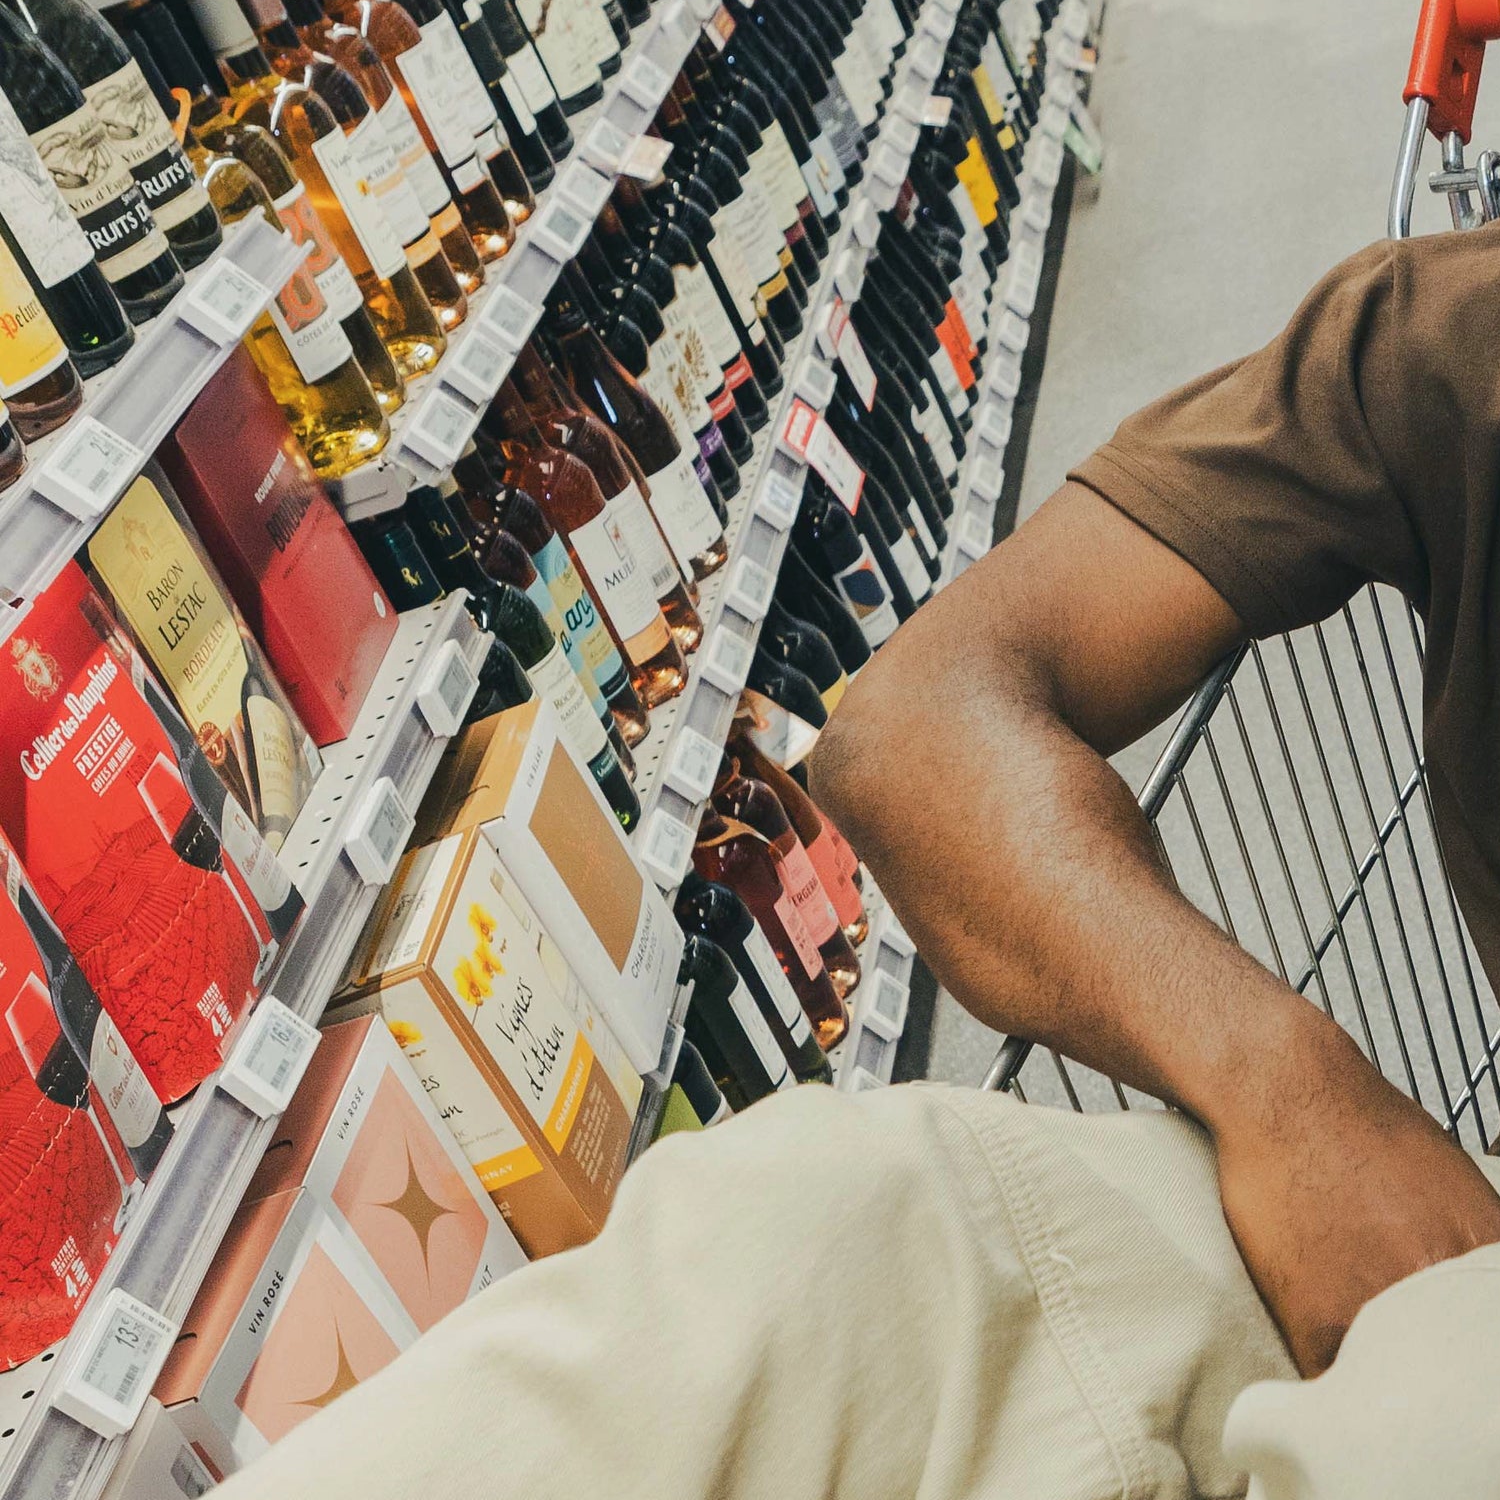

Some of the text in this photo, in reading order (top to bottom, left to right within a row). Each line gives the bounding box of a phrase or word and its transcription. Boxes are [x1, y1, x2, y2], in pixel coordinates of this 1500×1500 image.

[254, 477, 275, 504] ROUGE
[145, 558, 185, 613] BARON
[157, 580, 207, 652] LESTAC
[63, 651, 119, 724] Dauphins
[60, 712, 80, 741] des
[75, 716, 124, 778] PRESTIGE
[211, 743, 223, 759] 2
[19, 729, 66, 782] Cellier
[630, 905, 656, 980] CHARDONNAY
[209, 1012, 225, 1038] 4
[496, 975, 537, 1048] Vignes
[336, 1084, 367, 1142] VIN ROSÉ
[555, 1059, 585, 1133] CHARDONNAY
[64, 1273, 79, 1299] 4
[247, 1268, 286, 1336] VIN ROSÉ
[114, 1326, 140, 1349] 13
